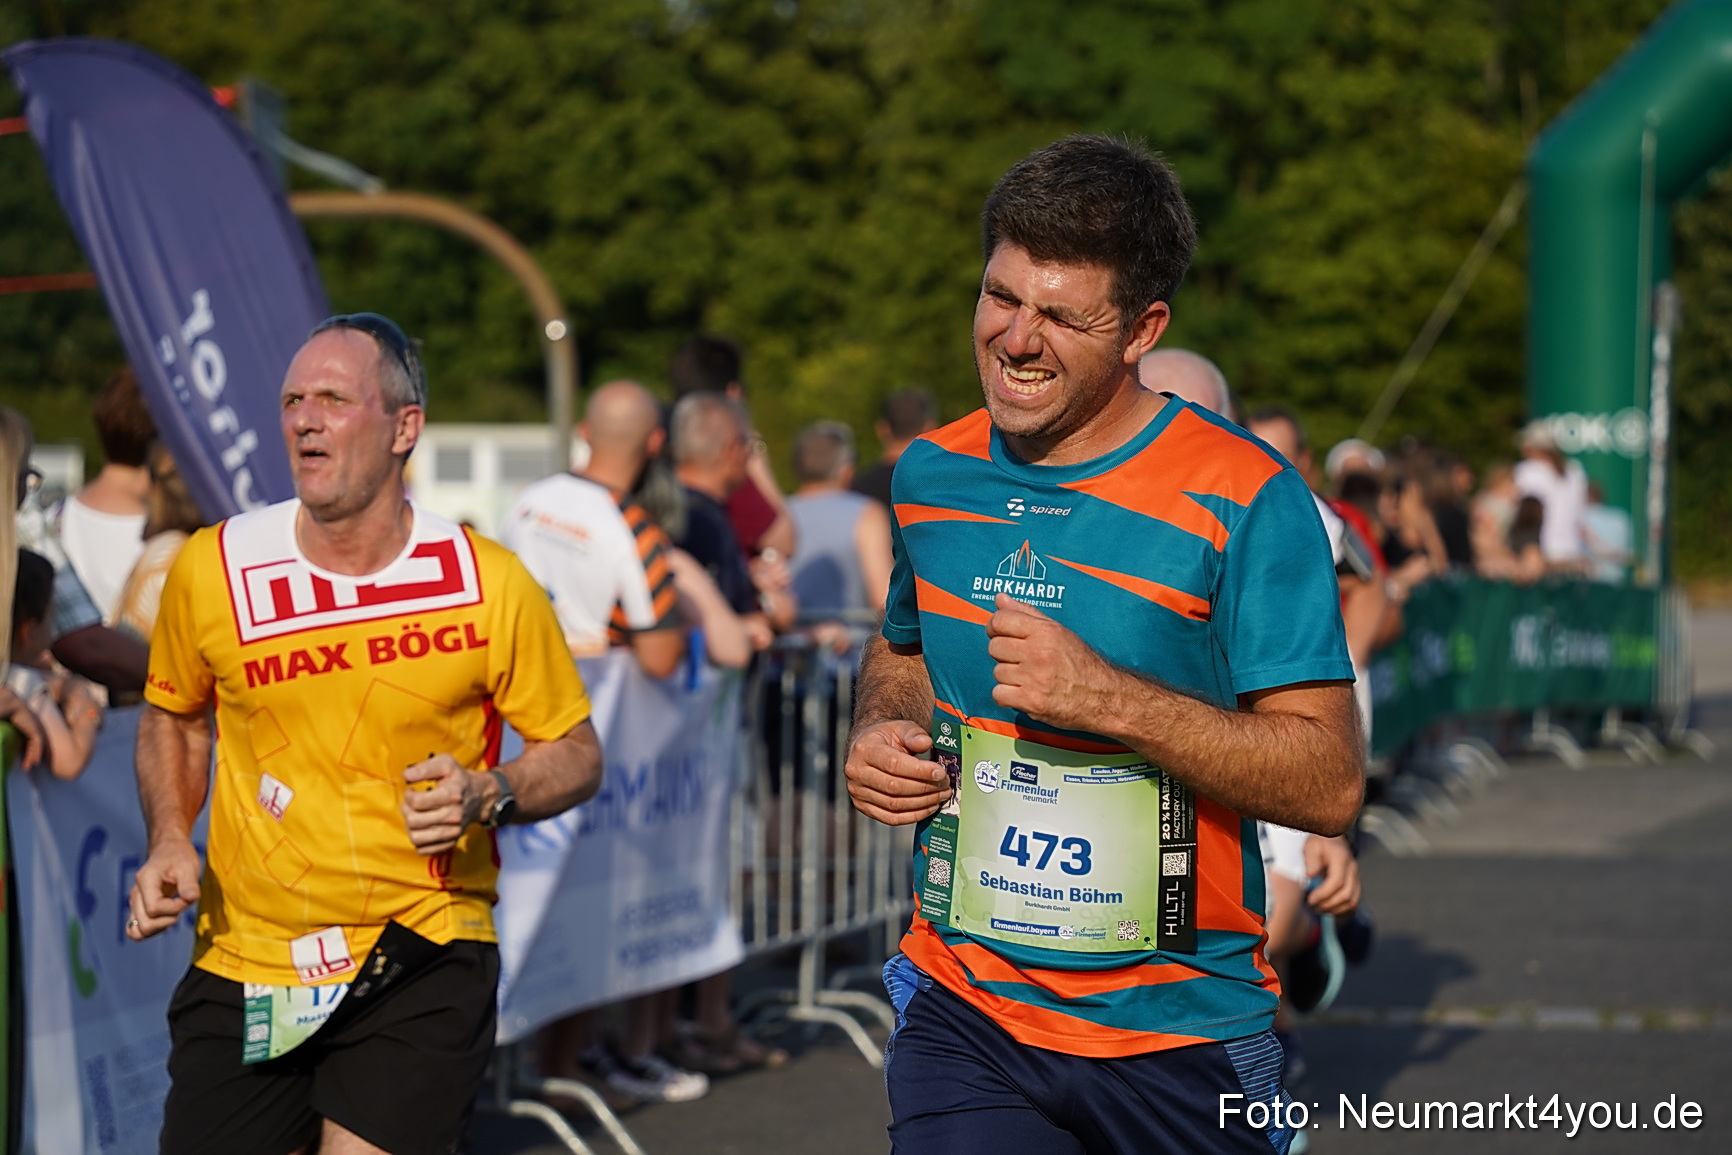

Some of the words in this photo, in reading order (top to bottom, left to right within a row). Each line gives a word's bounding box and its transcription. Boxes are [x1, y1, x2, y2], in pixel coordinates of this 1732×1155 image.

[1029, 505, 1072, 516] spized
[971, 592, 996, 602] ENERGIE
[973, 577, 1066, 600] BURKHARDT
[243, 640, 354, 689] MAX
[366, 622, 489, 666] BÖGL
[936, 735, 958, 749] AOK
[1001, 780, 1059, 798] Firmenlauf
[1162, 769, 1171, 811] RABAT
[1173, 779, 1181, 798] OUT
[1023, 794, 1058, 805] neumarkt
[1162, 812, 1171, 821] %
[1173, 799, 1181, 839] FACTORY
[1162, 823, 1171, 840] 20
[999, 825, 1092, 876] 473
[979, 870, 1064, 901] Sebastian
[1069, 887, 1123, 904] Böhm
[1024, 900, 1053, 911] Burkhardt
[1165, 881, 1179, 935] HILTL
[993, 920, 1056, 936] firmenlauf.bayern
